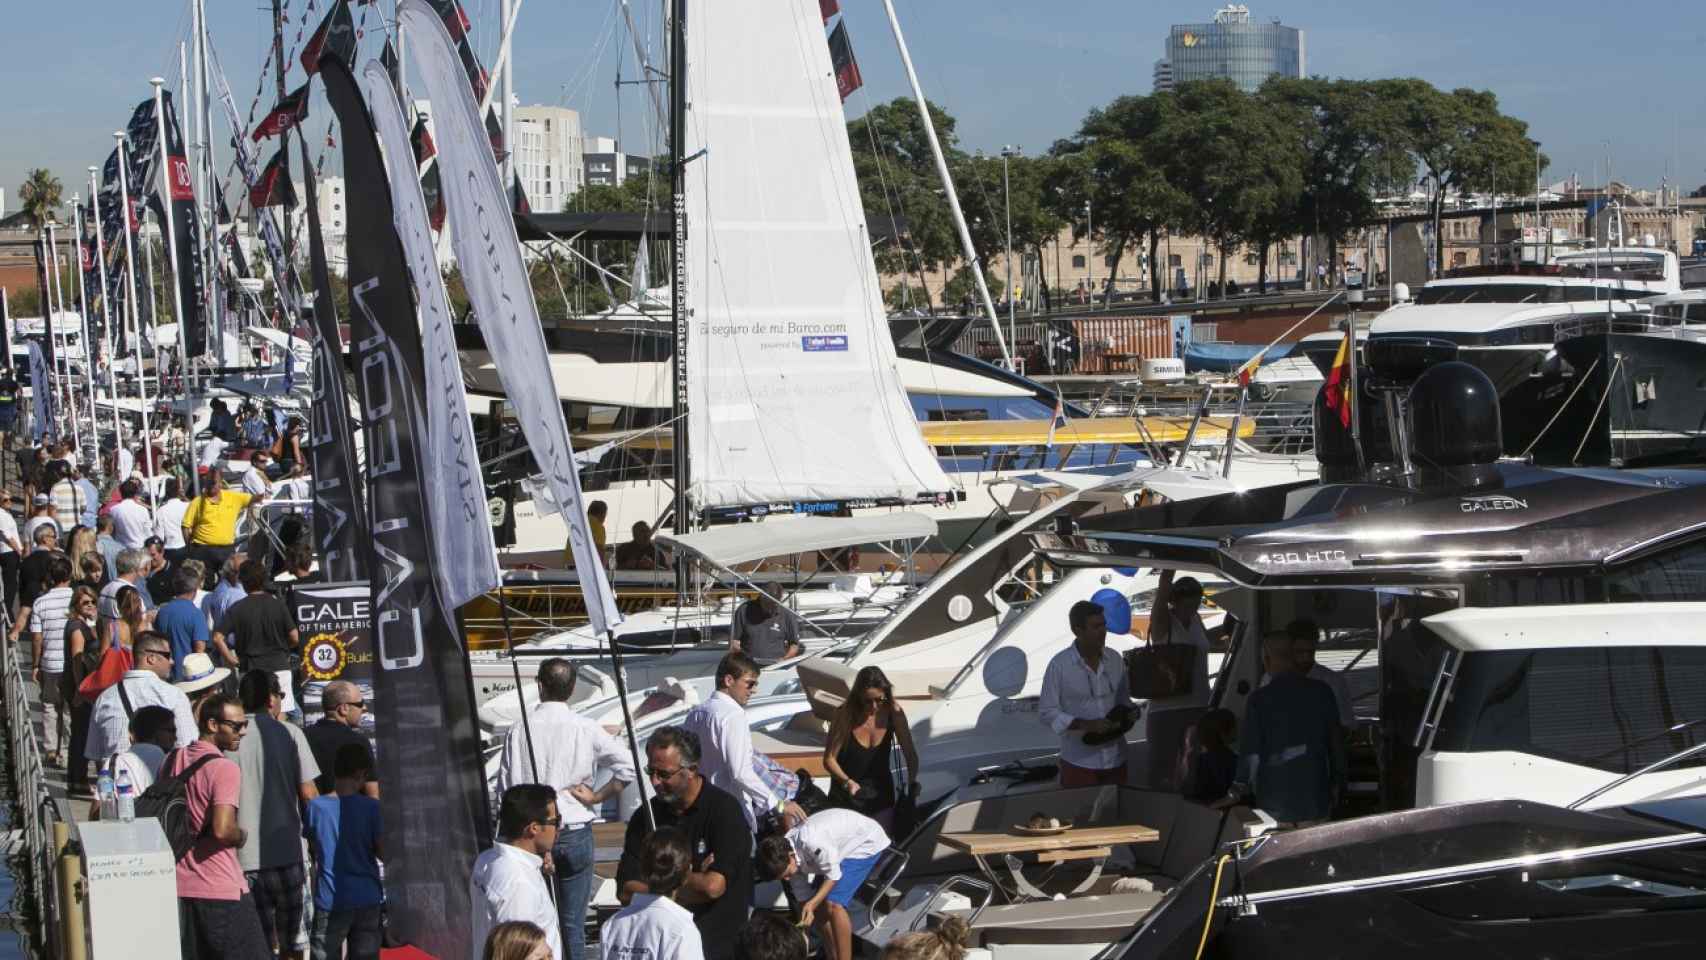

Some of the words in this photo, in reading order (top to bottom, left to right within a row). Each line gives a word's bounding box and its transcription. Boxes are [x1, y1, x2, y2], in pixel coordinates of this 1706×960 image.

[711, 324, 748, 338] seguro
[751, 321, 767, 335] de
[769, 323, 783, 335] mi
[787, 321, 847, 335] Barco.com
[354, 276, 424, 670] GALEON
[1460, 499, 1529, 512] GALEON
[1256, 553, 1299, 564] 430
[1305, 550, 1345, 562] HTC
[299, 623, 311, 632] OF
[313, 622, 332, 632] THE
[318, 648, 332, 662] 32
